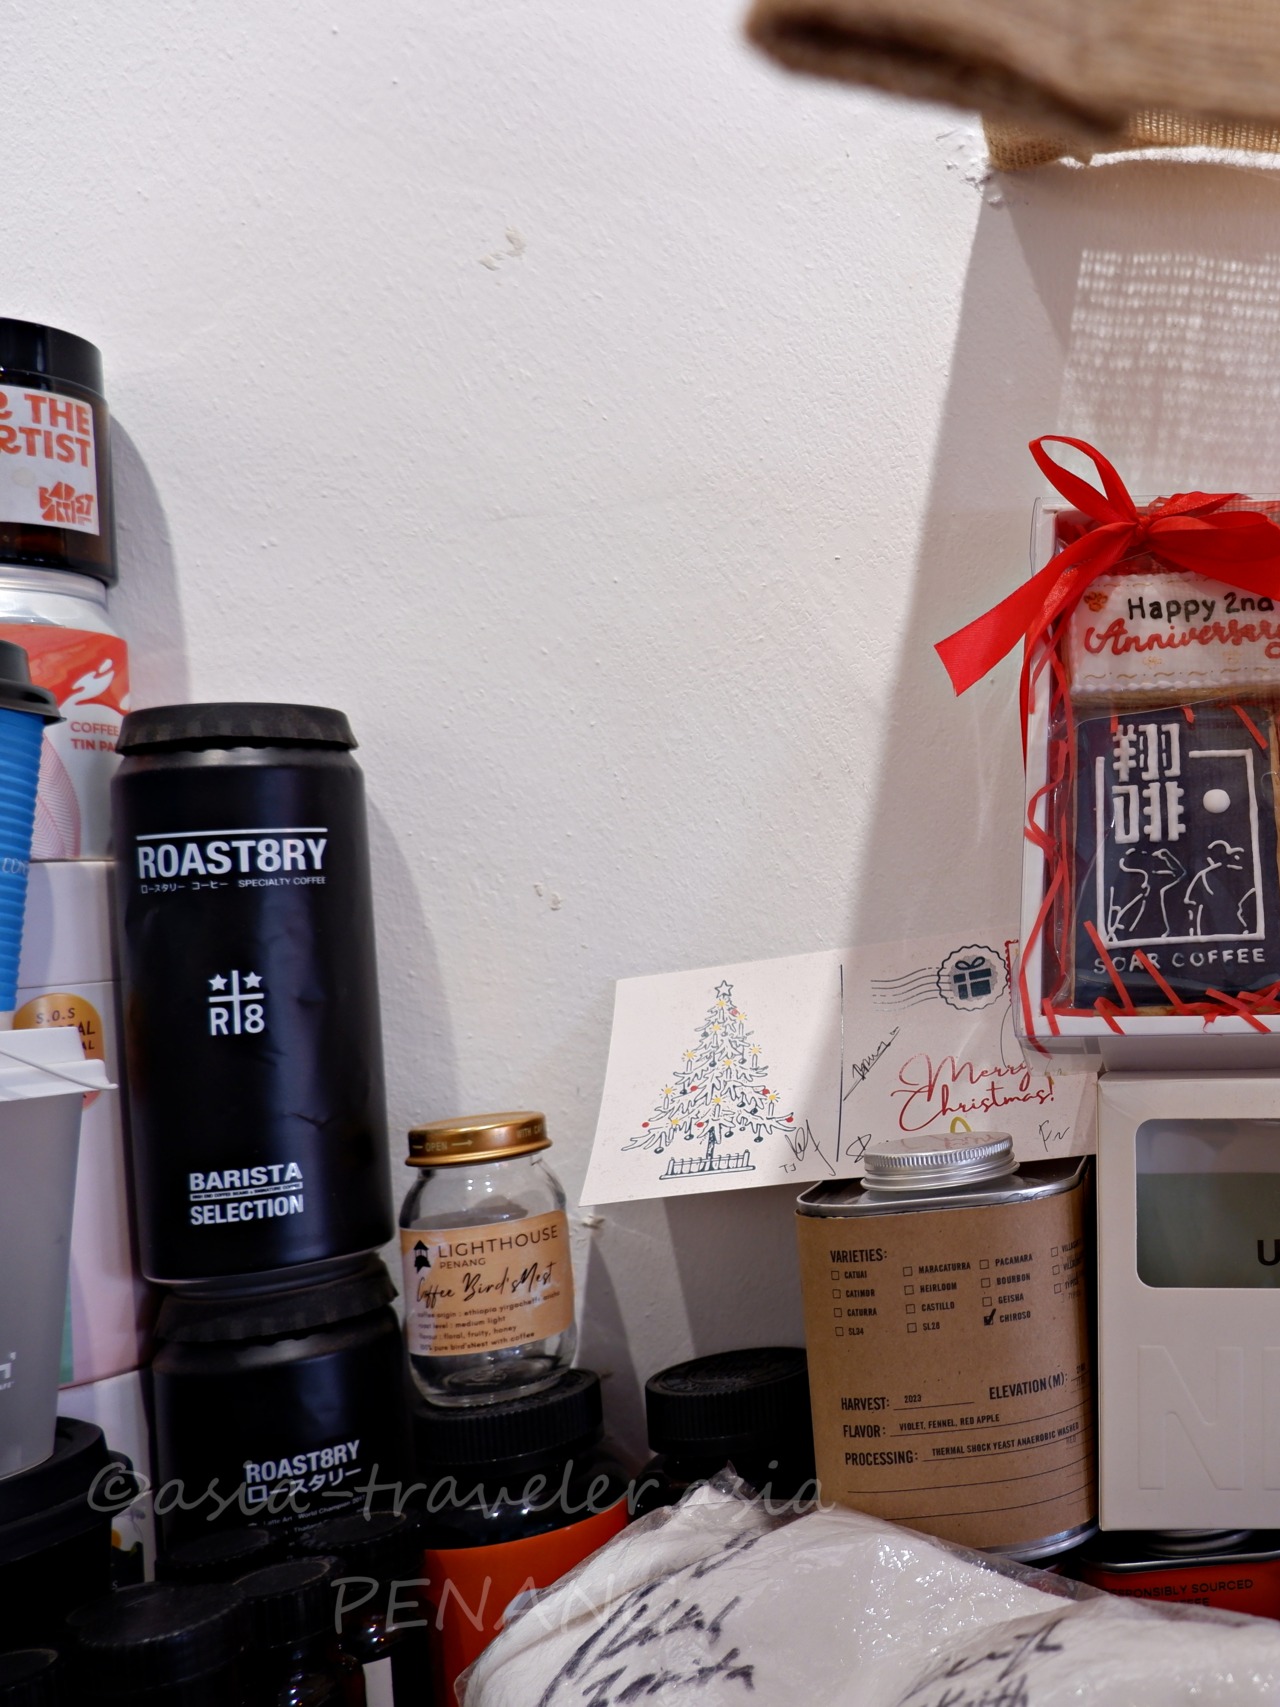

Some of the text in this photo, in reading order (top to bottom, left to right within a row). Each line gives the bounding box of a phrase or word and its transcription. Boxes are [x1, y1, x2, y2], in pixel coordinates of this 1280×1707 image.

[24, 393, 91, 436] THE
[0, 424, 91, 467] RTIST
[1128, 595, 1216, 623] Happy
[71, 721, 120, 736] COFFEE
[71, 738, 116, 752] TIN PA
[138, 838, 327, 879] ROAST8RY
[238, 876, 326, 888] SPECIALTY COFFEE
[1172, 948, 1266, 968] COFFEE
[899, 1053, 1032, 1102] Merry
[890, 1075, 1055, 1131] Christmas!
[189, 1162, 303, 1191] BARISTA
[190, 1194, 304, 1226] SELECTION
[438, 1225, 558, 1258] LIGHTHOUSE
[440, 1257, 486, 1270] PENANG
[830, 1248, 887, 1263] VARIETIES:
[918, 1262, 971, 1274] MARACATURRA
[995, 1254, 1033, 1267] PACAMARA
[416, 1276, 455, 1309] Coffee
[845, 1289, 875, 1298] CATIMOR
[920, 1282, 957, 1293] HEIRLOOM
[996, 1273, 1031, 1285] BOURBON
[464, 1307, 497, 1317] ethiopia
[847, 1293, 1024, 1317] CATURRA CASTILLO GEISHA
[455, 1320, 485, 1328] medium
[487, 1316, 506, 1326] light
[493, 1326, 517, 1335] honey
[923, 1322, 940, 1331] SL28
[1000, 1311, 1031, 1323] CHIROSO
[491, 1338, 508, 1346] with
[510, 1332, 535, 1342] coffee
[841, 1397, 890, 1411] HARVEST:
[904, 1394, 922, 1403] 2023
[960, 1416, 974, 1426] RED
[976, 1414, 1000, 1424] APPLE
[845, 1450, 918, 1466] PROCESSING:
[932, 1445, 964, 1456] THERMAL
[967, 1444, 991, 1453] SHOCK
[993, 1440, 1015, 1450] YEAST
[1017, 1430, 1056, 1447] ANAEROBIC
[1057, 1422, 1079, 1436] WASHED
[246, 1440, 360, 1483] ROAST8RY
[247, 1468, 361, 1503] ロースタリー
[1192, 1579, 1253, 1593] SOURCED
